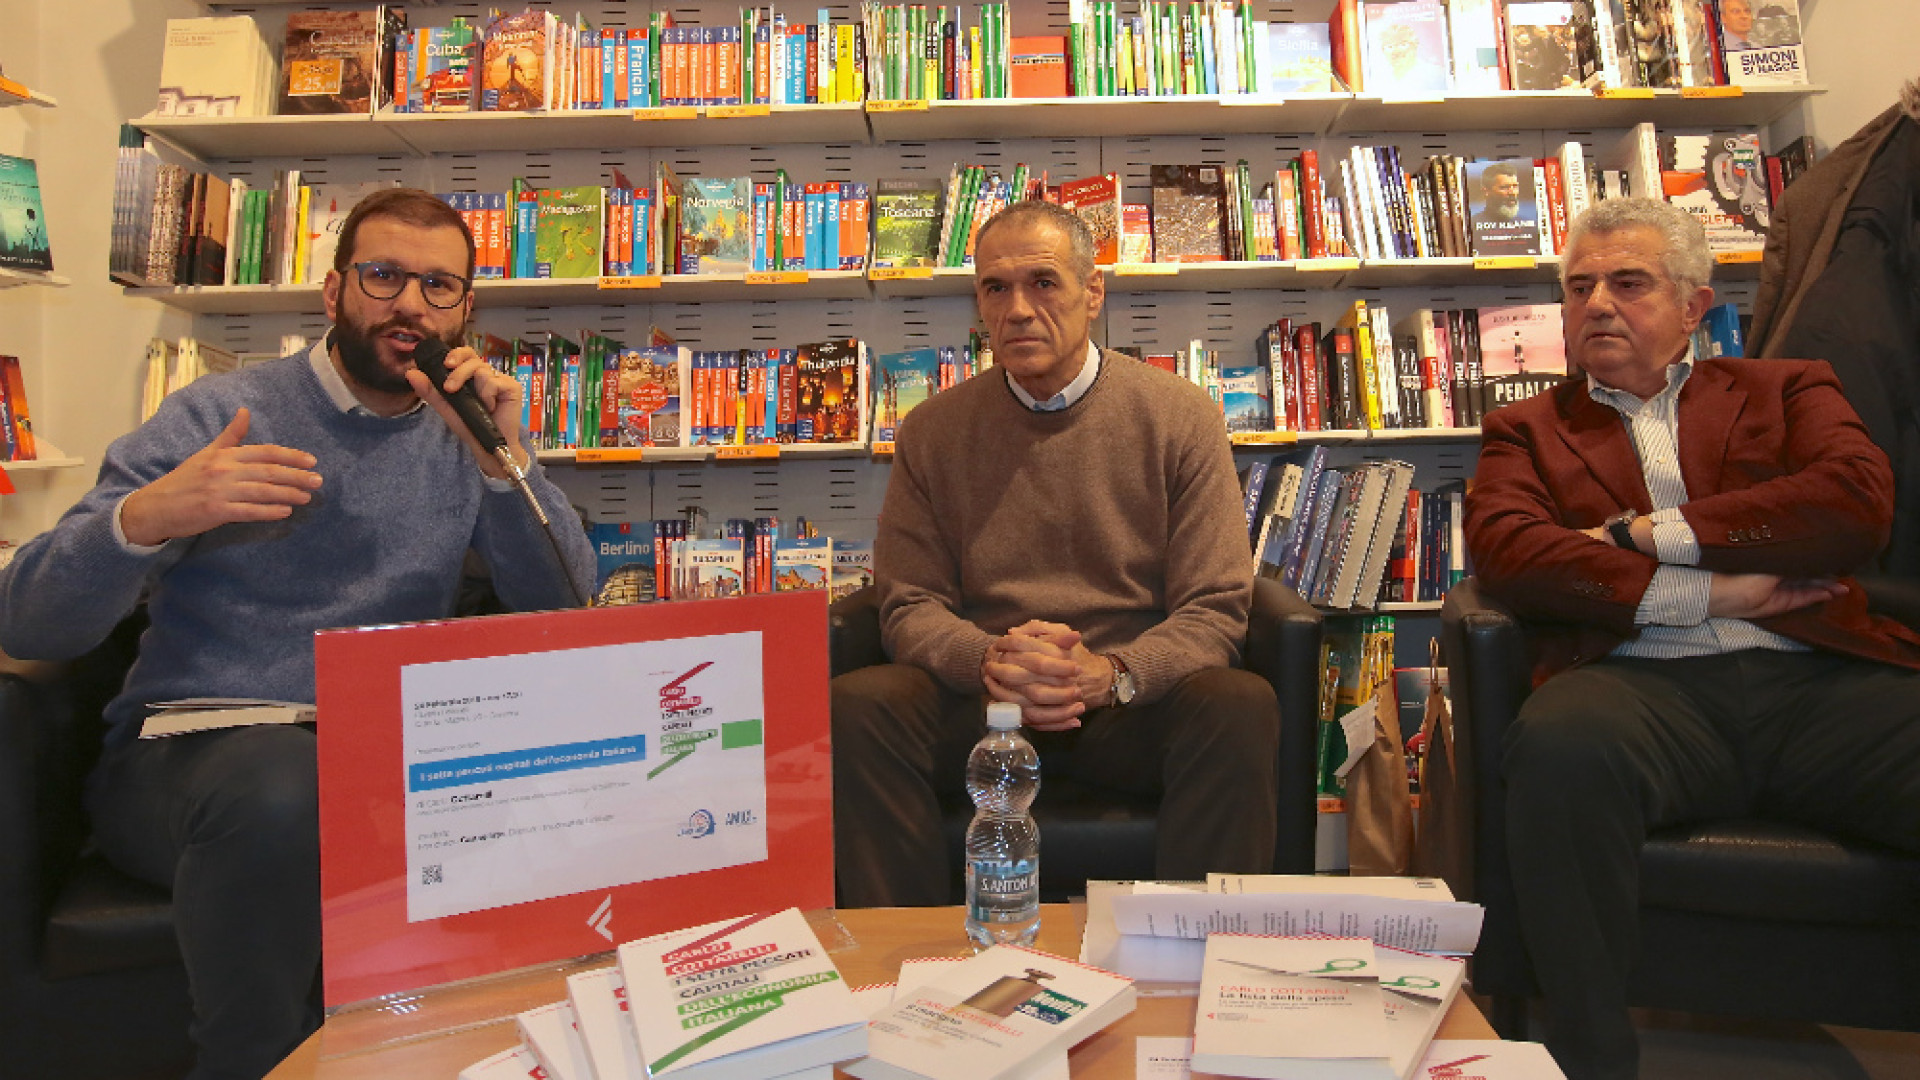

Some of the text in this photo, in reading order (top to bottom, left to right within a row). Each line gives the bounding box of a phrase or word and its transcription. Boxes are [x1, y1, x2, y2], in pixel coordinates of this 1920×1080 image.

[425, 44, 461, 57] Cuba
[1278, 39, 1318, 50] Sicilia
[1741, 50, 1797, 65] SIMONI
[630, 44, 644, 96] Francia
[1758, 61, 1800, 74] NASCE
[540, 203, 598, 216] Madagascar
[686, 196, 744, 210] Norvegia
[881, 206, 936, 218] Toscana
[490, 211, 501, 249] Irlanda
[1476, 220, 1536, 231] ROY KEANE
[800, 355, 856, 370] Thailandia
[1495, 381, 1558, 402] PEDAL
[600, 541, 651, 556] Berlino
[427, 769, 454, 781] sette
[456, 764, 493, 779] peccati
[495, 759, 531, 774] capitali
[534, 750, 600, 768] dell'economia
[602, 746, 637, 758] italiana
[667, 942, 725, 962] CARLO
[671, 945, 773, 975] COTTARELLI
[686, 966, 738, 982] SETTE
[741, 949, 812, 971] PECCATI
[679, 974, 760, 999] CAPITALI
[1220, 985, 1350, 995] CARLO COTTARELLI
[1220, 991, 1235, 999] La
[1239, 992, 1267, 1000] lista
[1270, 993, 1303, 1001] della
[688, 999, 777, 1027] ITALIANA
